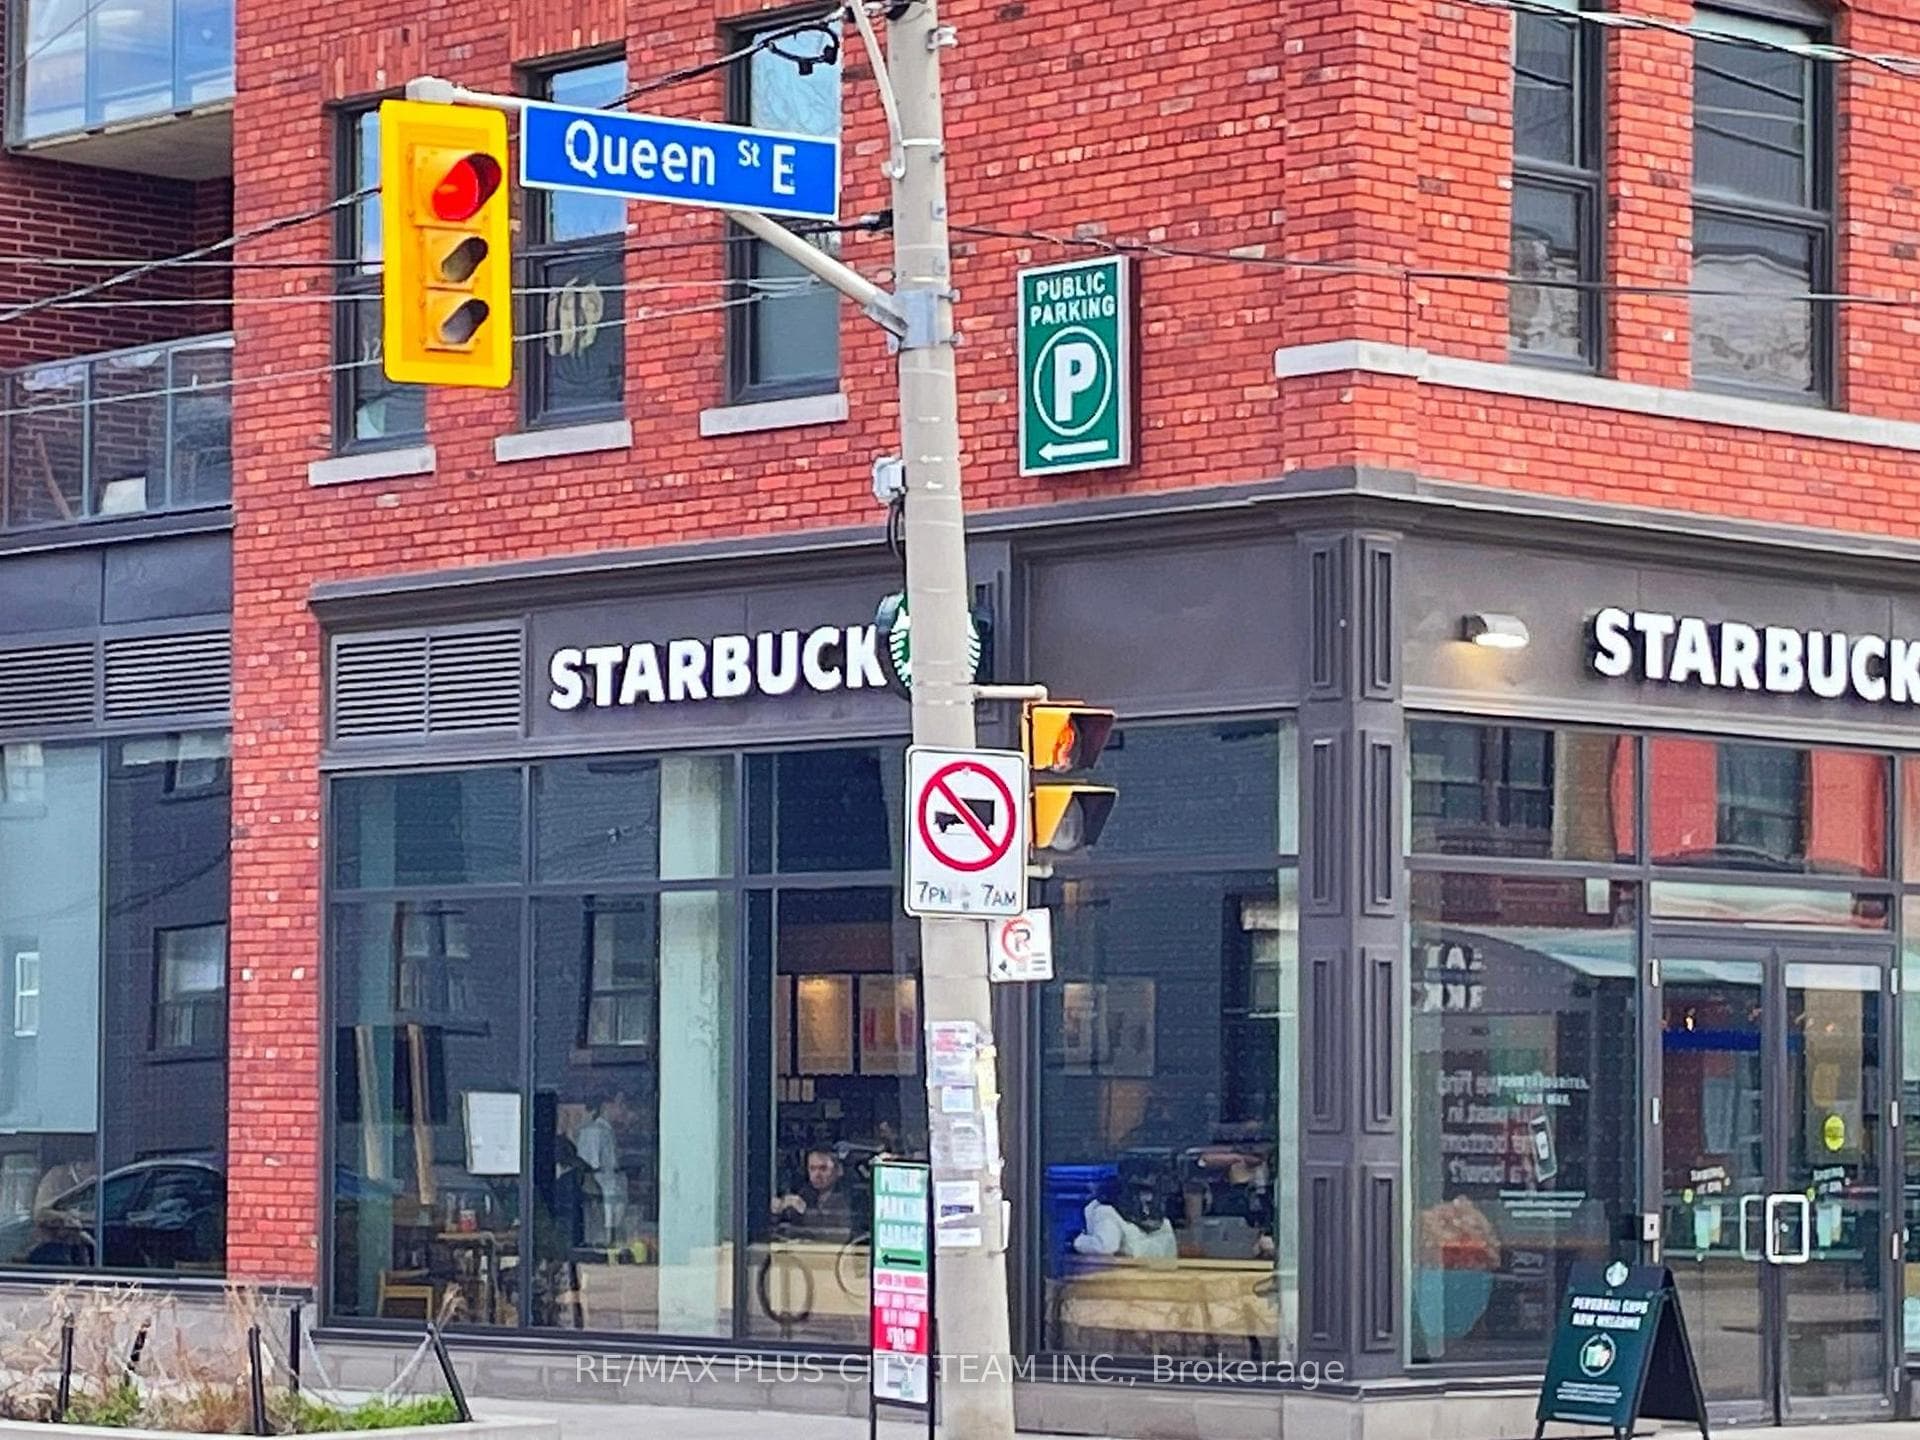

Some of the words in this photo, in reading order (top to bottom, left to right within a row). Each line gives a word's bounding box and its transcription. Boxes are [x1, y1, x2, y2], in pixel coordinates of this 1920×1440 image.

[565, 119, 716, 186] Queen
[738, 138, 760, 168] St
[772, 145, 797, 195] E
[1030, 295, 1115, 327] PARKING
[1036, 271, 1106, 302] PUBLIC
[1054, 342, 1097, 422] P
[549, 623, 888, 711] STARBUCK
[1593, 606, 1920, 705] STARBUCK
[916, 880, 952, 904] 7PM
[981, 883, 1017, 907] 7AM
